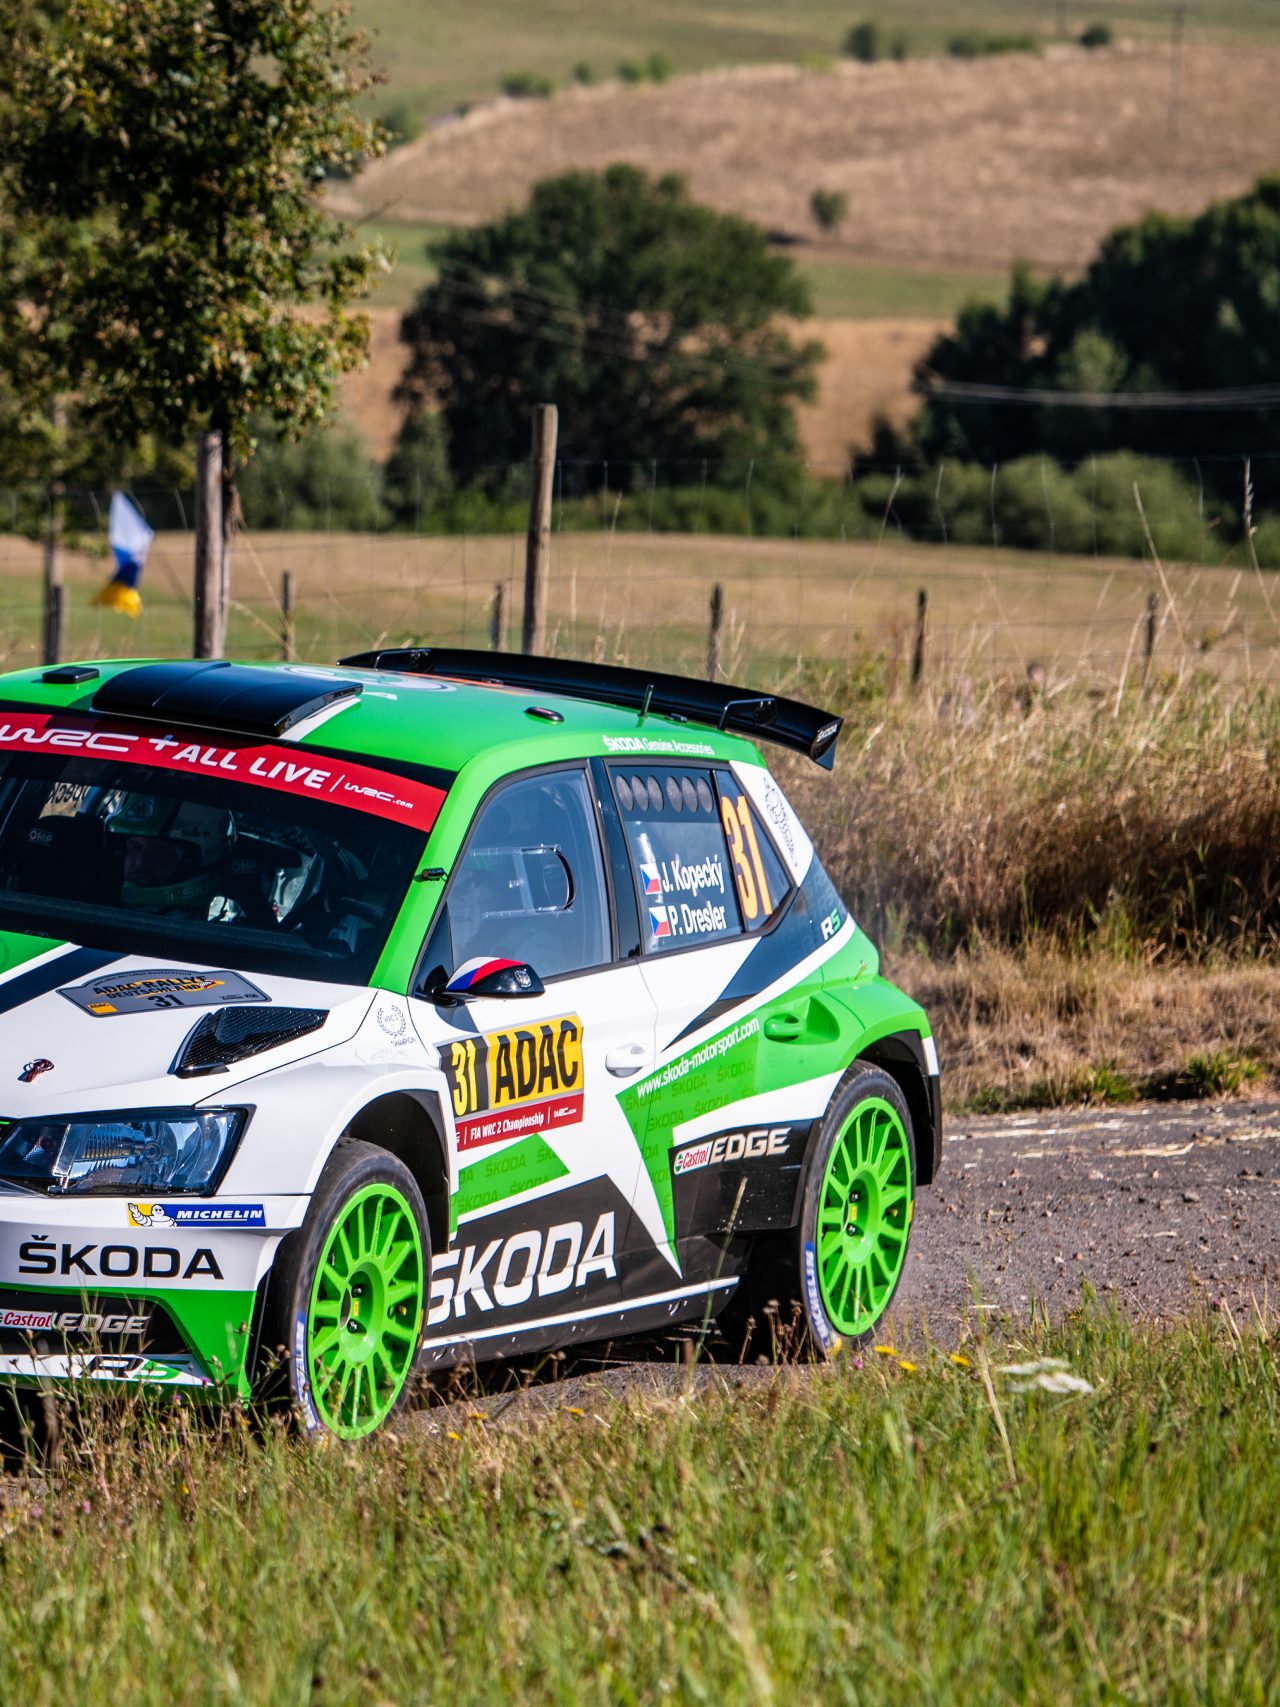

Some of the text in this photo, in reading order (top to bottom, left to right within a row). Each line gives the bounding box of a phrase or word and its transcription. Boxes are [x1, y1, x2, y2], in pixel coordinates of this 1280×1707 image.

[602, 734, 646, 752] ŠKODA
[172, 744, 238, 771] ALL
[249, 757, 331, 789] LIVE
[720, 795, 773, 920] 31
[661, 853, 725, 897] J. Kopecký
[668, 900, 727, 937] P. Dresler
[821, 908, 841, 941] R5
[93, 975, 209, 995] ADAC RALLYE
[106, 984, 202, 1000] DEUTSCHLAND
[148, 994, 185, 1009] 31
[451, 1019, 579, 1116] 31 ADAC
[636, 1017, 760, 1100] www.skoda-motorsport.com
[470, 1125, 481, 1141] FIA
[482, 1123, 497, 1138] WRC
[497, 1121, 503, 1135] 2
[502, 1112, 545, 1133] Championship
[682, 1148, 710, 1169] Castrol
[709, 1127, 792, 1166] EDGE
[176, 1209, 264, 1219] MICHELIN
[18, 1234, 225, 1280] ŠKODA
[3, 1310, 151, 1335] Castrol EDGE
[79, 1355, 191, 1381] R5
